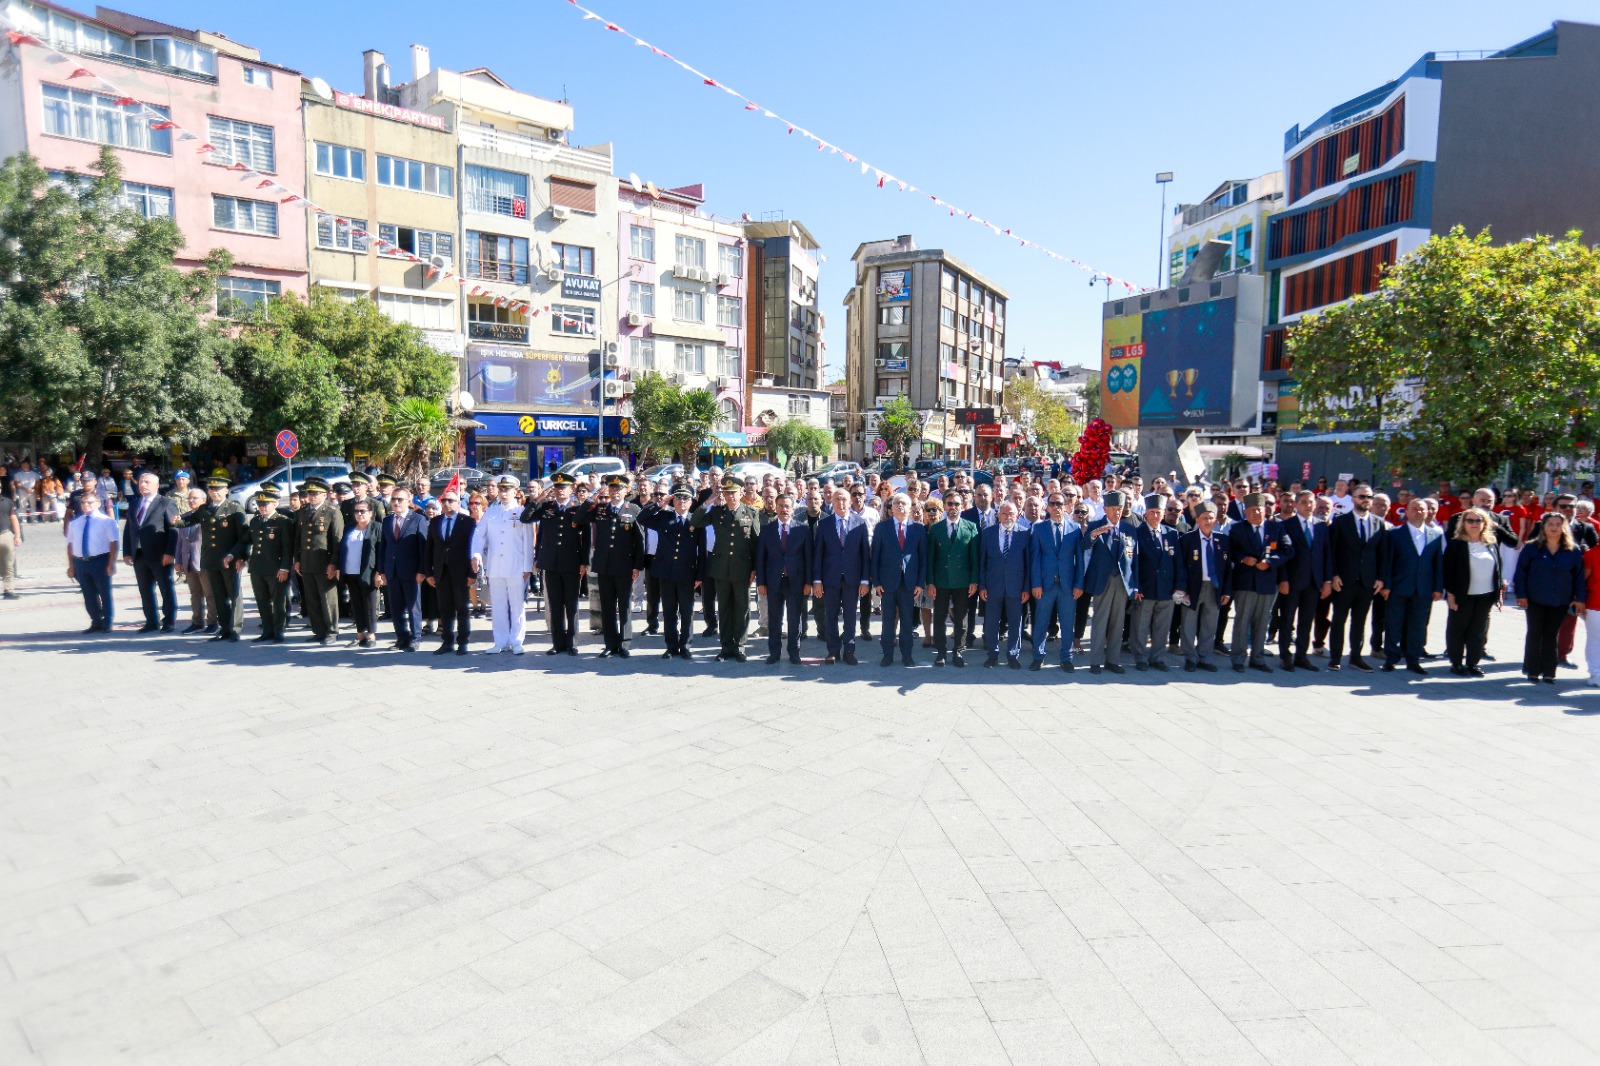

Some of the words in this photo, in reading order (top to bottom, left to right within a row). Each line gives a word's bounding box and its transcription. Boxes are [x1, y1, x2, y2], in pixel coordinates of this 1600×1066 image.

[354, 98, 389, 116] EMEK
[565, 277, 600, 291] AVUKAT
[1126, 344, 1143, 357] LGS
[564, 354, 590, 363] BURADA
[966, 411, 977, 421] 24
[536, 420, 588, 431] TURKCELL
